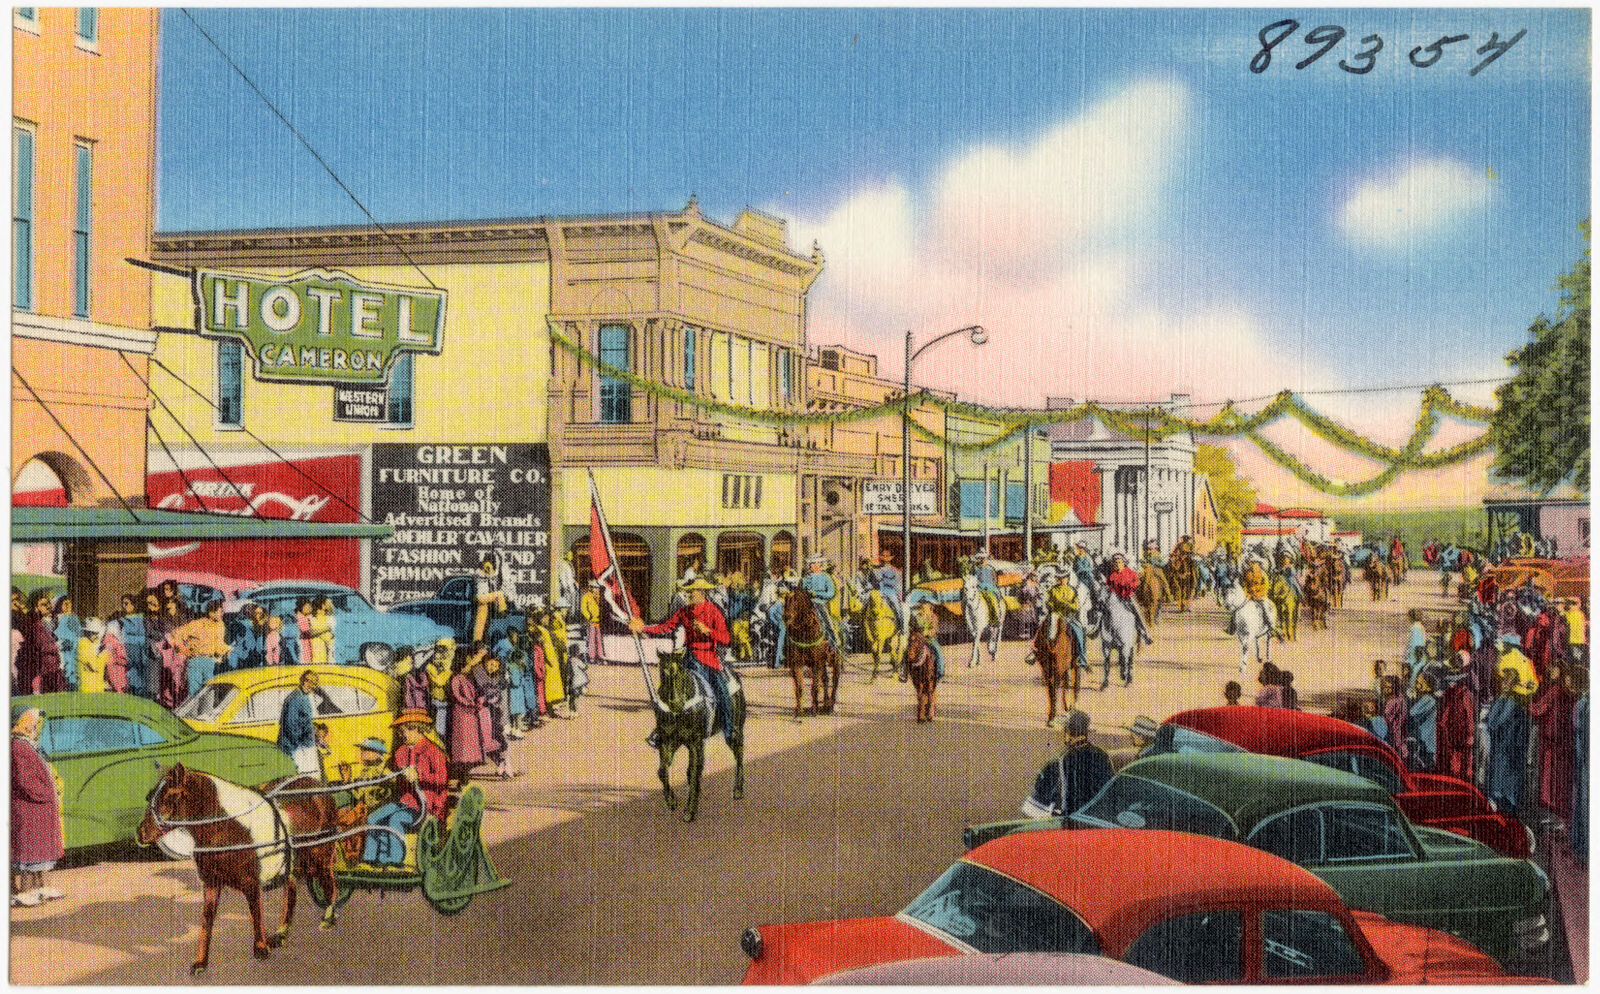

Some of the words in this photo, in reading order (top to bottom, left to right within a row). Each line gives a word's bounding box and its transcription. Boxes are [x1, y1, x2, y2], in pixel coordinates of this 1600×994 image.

[214, 278, 431, 343] HOTEL
[260, 343, 385, 371] CAMERON
[417, 445, 508, 464] GREEN
[379, 468, 496, 484] FURNITURE
[509, 468, 547, 484] CO.
[418, 485, 466, 500] Home
[474, 485, 495, 500] of
[418, 500, 501, 515] Nationally
[385, 512, 472, 527] Advertised
[479, 513, 542, 527] Brands
